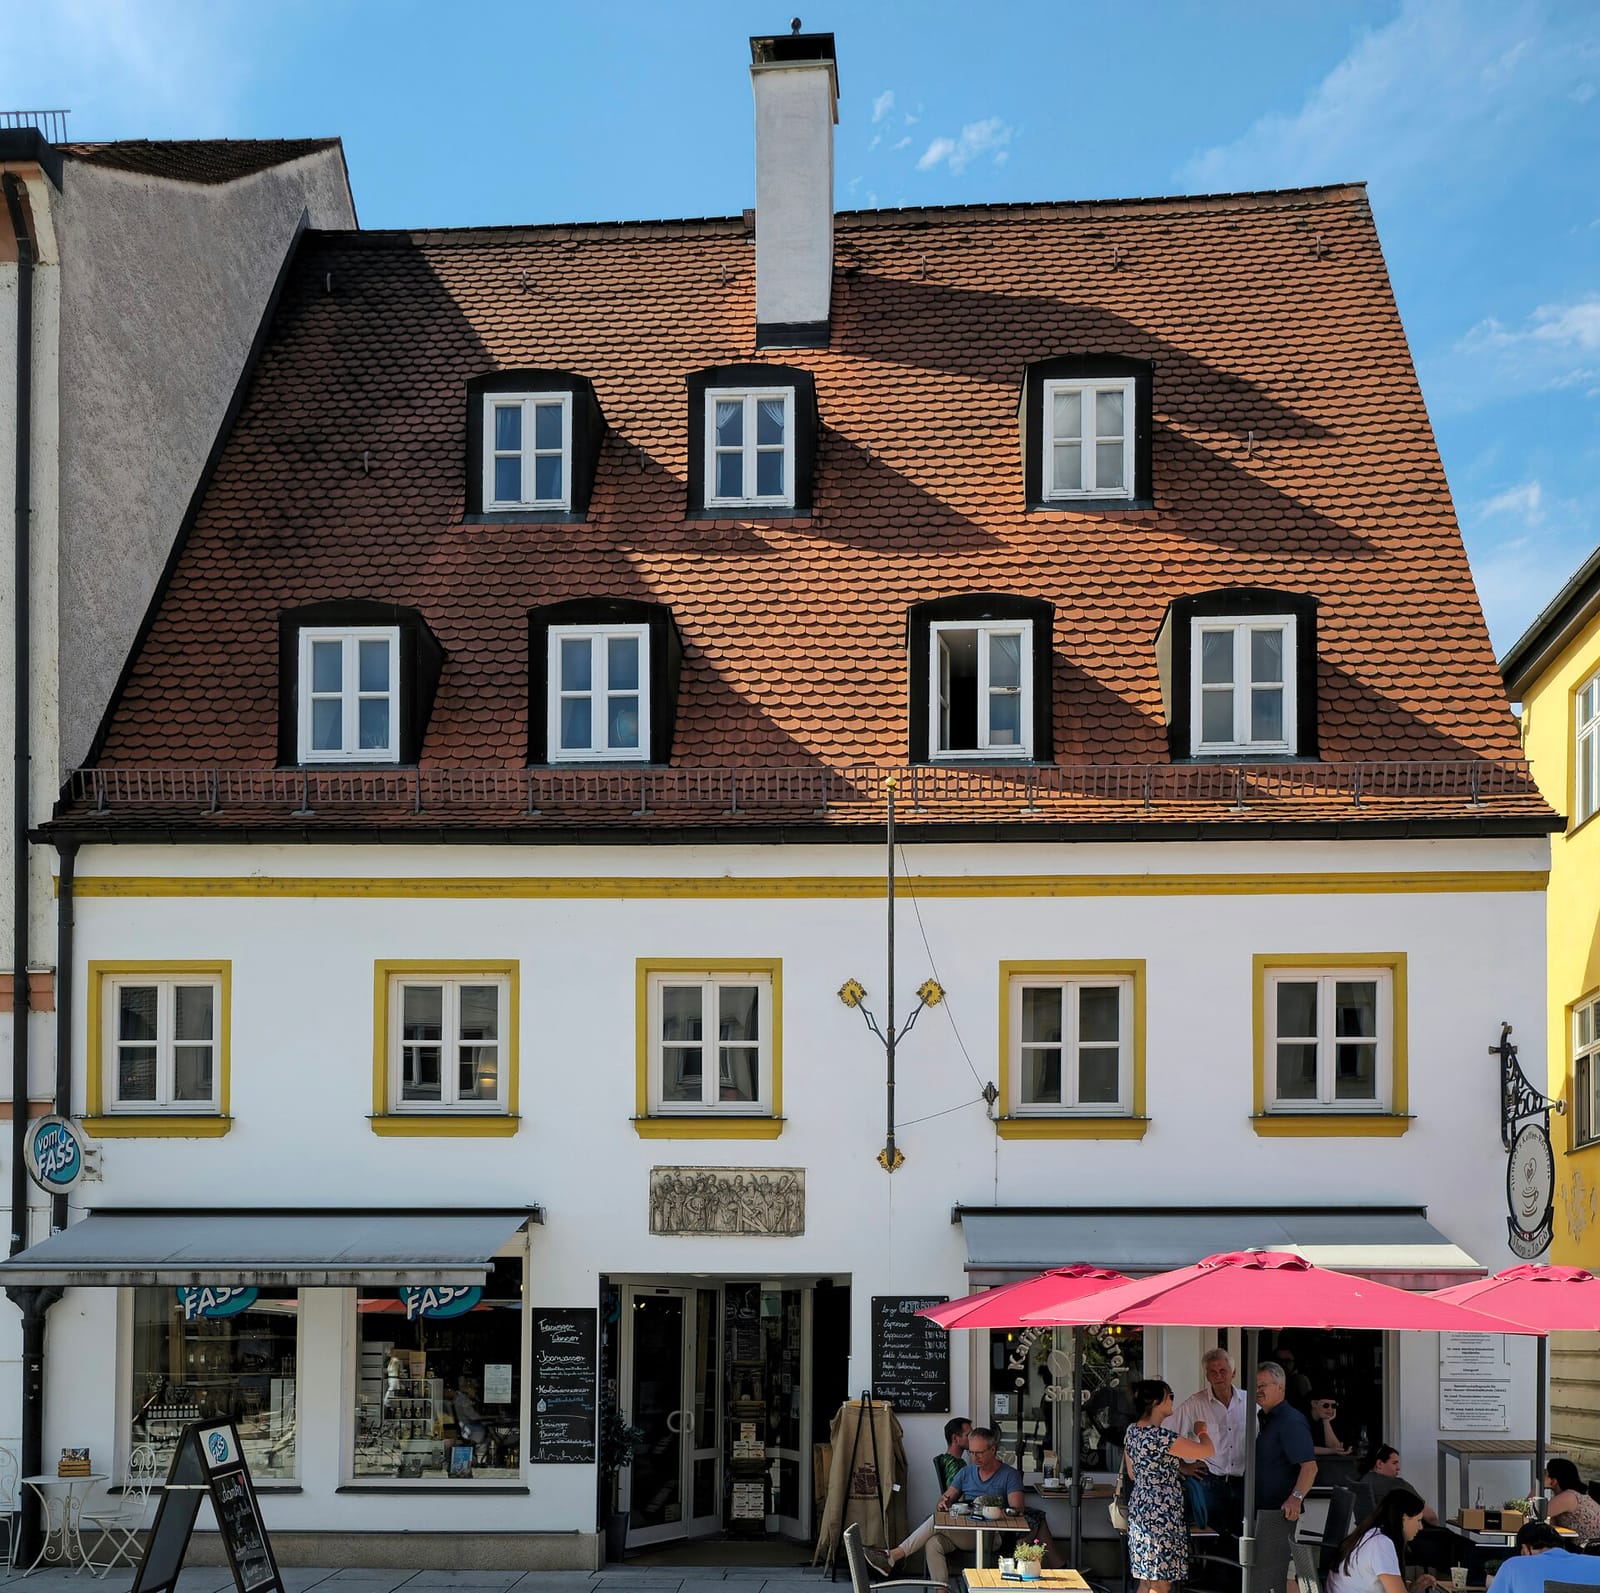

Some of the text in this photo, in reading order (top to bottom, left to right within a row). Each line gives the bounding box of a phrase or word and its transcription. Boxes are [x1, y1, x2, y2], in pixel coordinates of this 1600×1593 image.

[38, 1129, 58, 1152] vom
[38, 1137, 74, 1180] FASS
[1045, 1385, 1091, 1405] Shp
